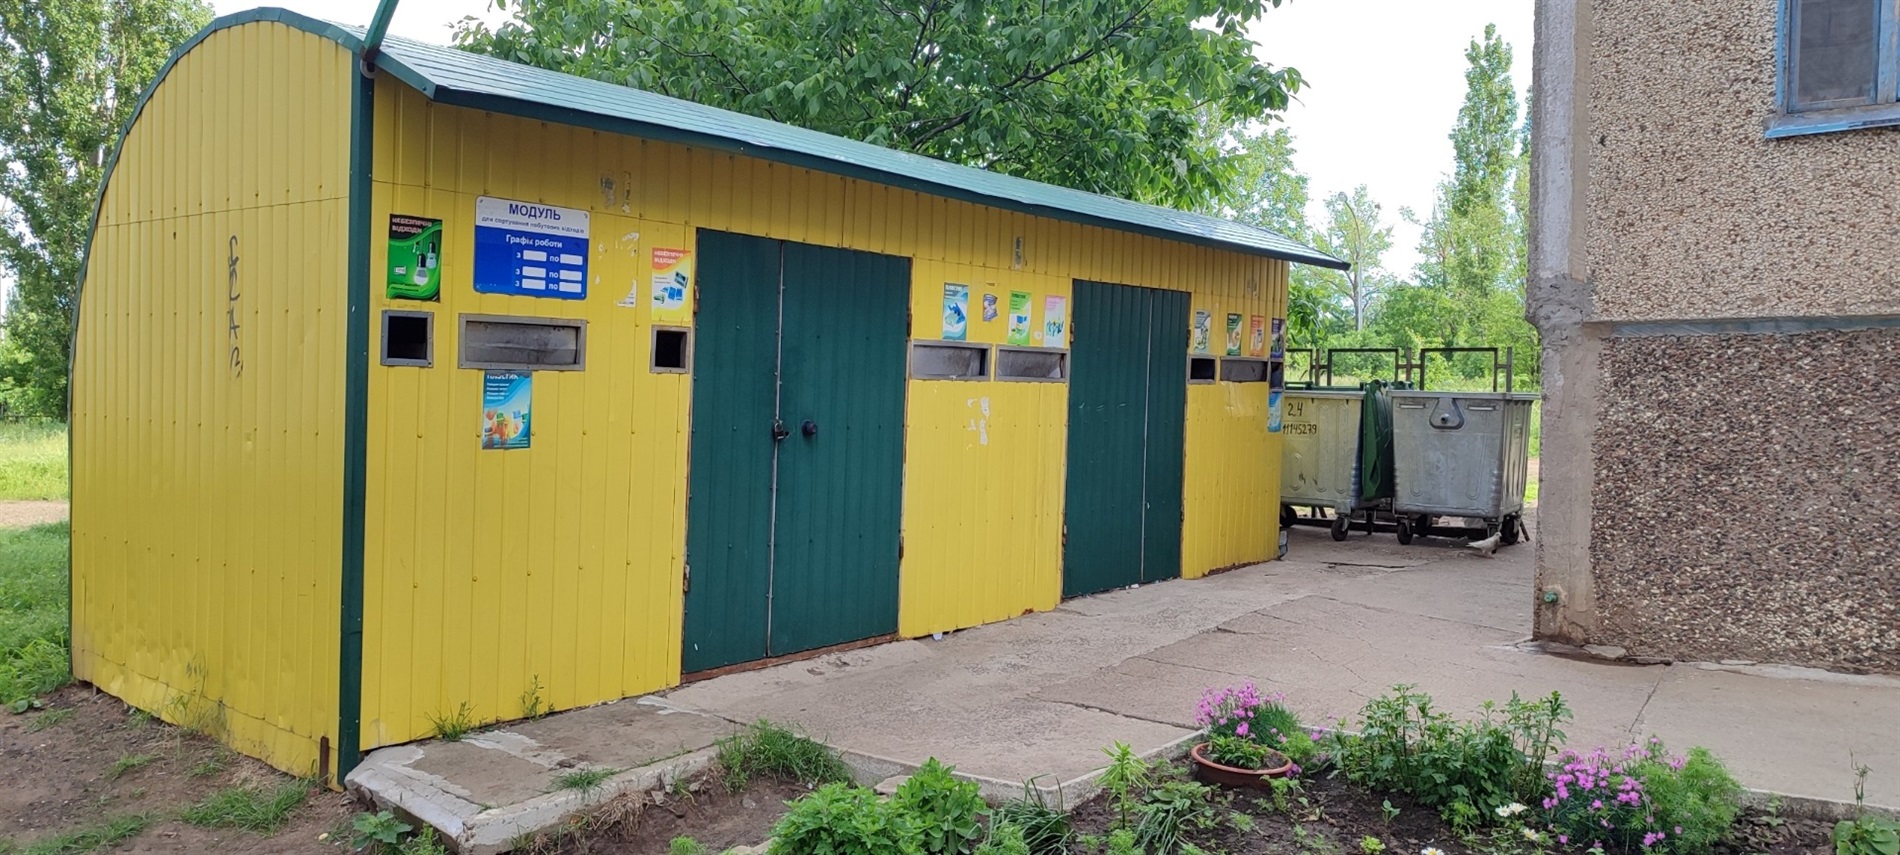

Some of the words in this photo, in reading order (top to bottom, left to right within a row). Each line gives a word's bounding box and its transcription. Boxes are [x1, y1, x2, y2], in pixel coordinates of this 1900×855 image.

[509, 203, 561, 221] МОДУЛЬ
[495, 217, 529, 227] сортування
[506, 234, 534, 246] Графік
[534, 239, 563, 248] роботи
